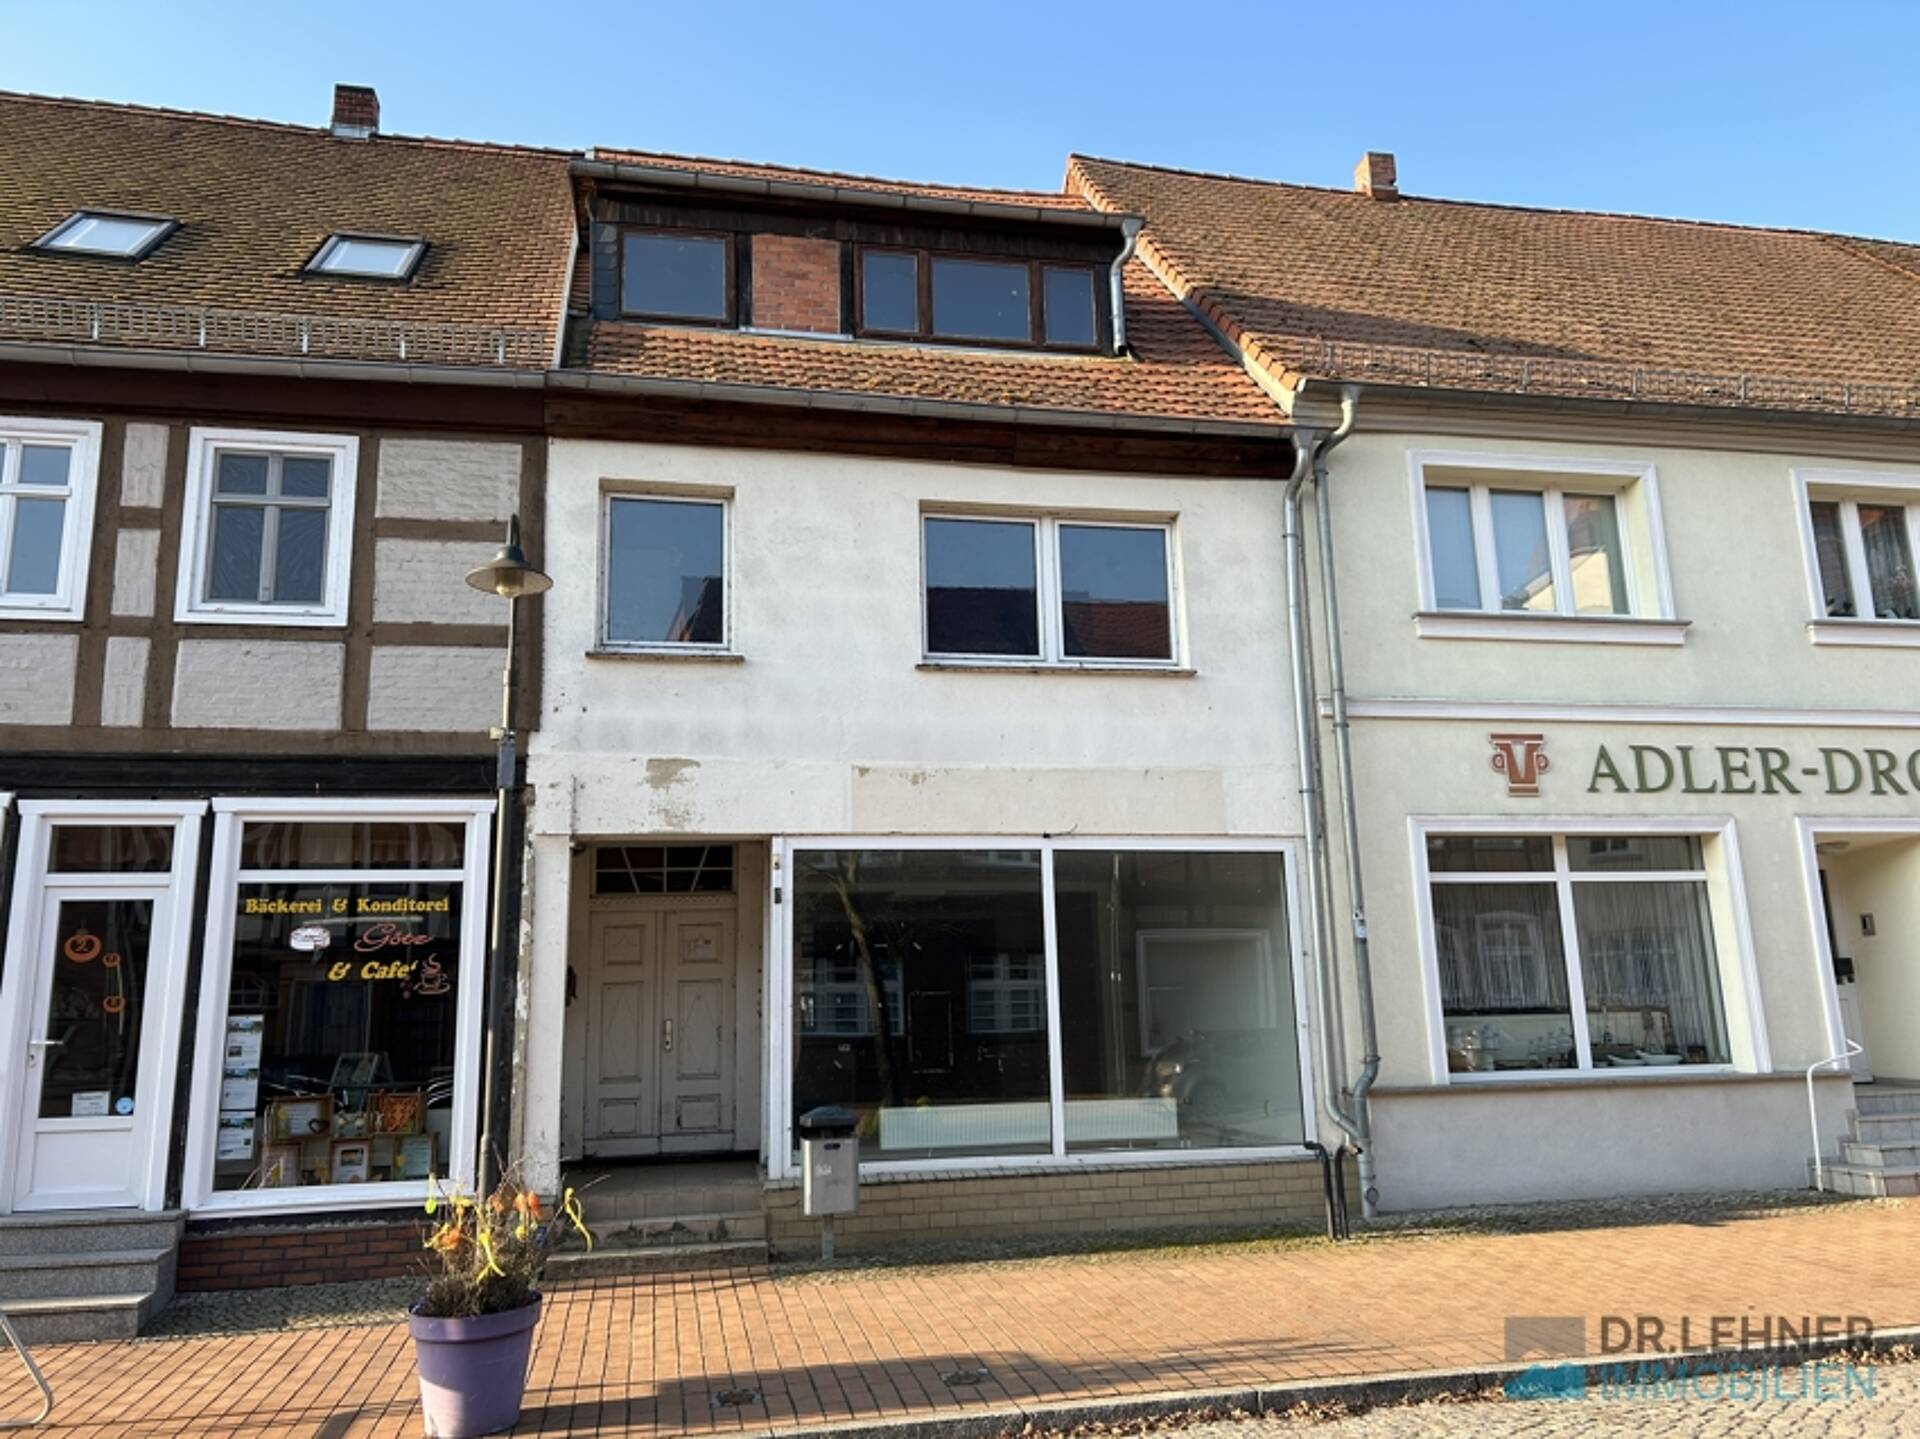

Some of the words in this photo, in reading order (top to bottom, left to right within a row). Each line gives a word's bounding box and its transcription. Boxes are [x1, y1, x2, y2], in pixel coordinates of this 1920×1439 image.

[1587, 744, 1920, 796] ADLER-DR
[245, 898, 322, 914] Bäckerei
[331, 899, 348, 912] &
[357, 898, 449, 912] Konditorei
[327, 962, 352, 981] &
